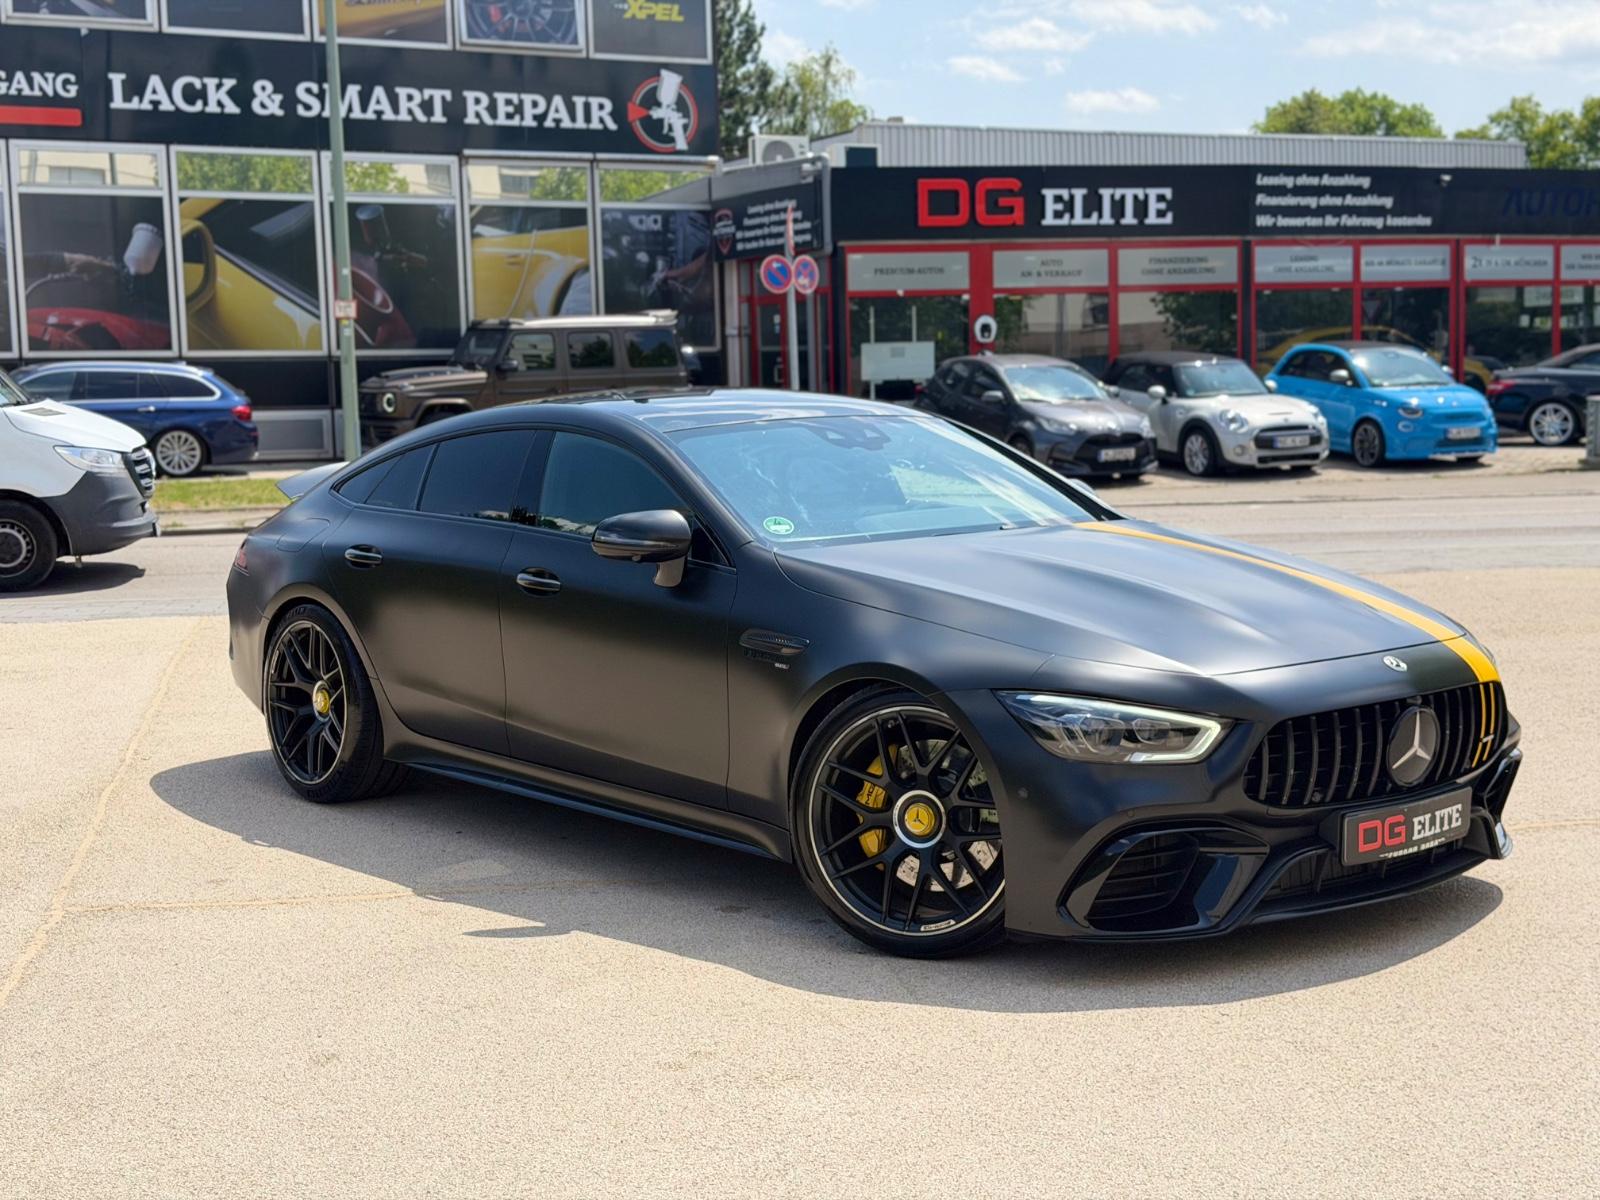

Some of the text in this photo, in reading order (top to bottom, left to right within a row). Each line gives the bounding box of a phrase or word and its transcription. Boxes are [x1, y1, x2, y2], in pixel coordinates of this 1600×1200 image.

[624, 0, 685, 21] XPEL
[107, 72, 618, 131] LACK & SMART REPAIR
[1256, 173, 1371, 189] Leasing ohne Anzahlung
[917, 178, 1174, 227] DG ELITE
[1255, 193, 1394, 209] Finanzierung ohne Anzahlung
[1255, 214, 1276, 227] Wir
[1276, 214, 1323, 227] bewerten
[1340, 214, 1385, 229] Fahrzeug
[1358, 814, 1407, 853] DG
[1412, 803, 1463, 841] ELITE
